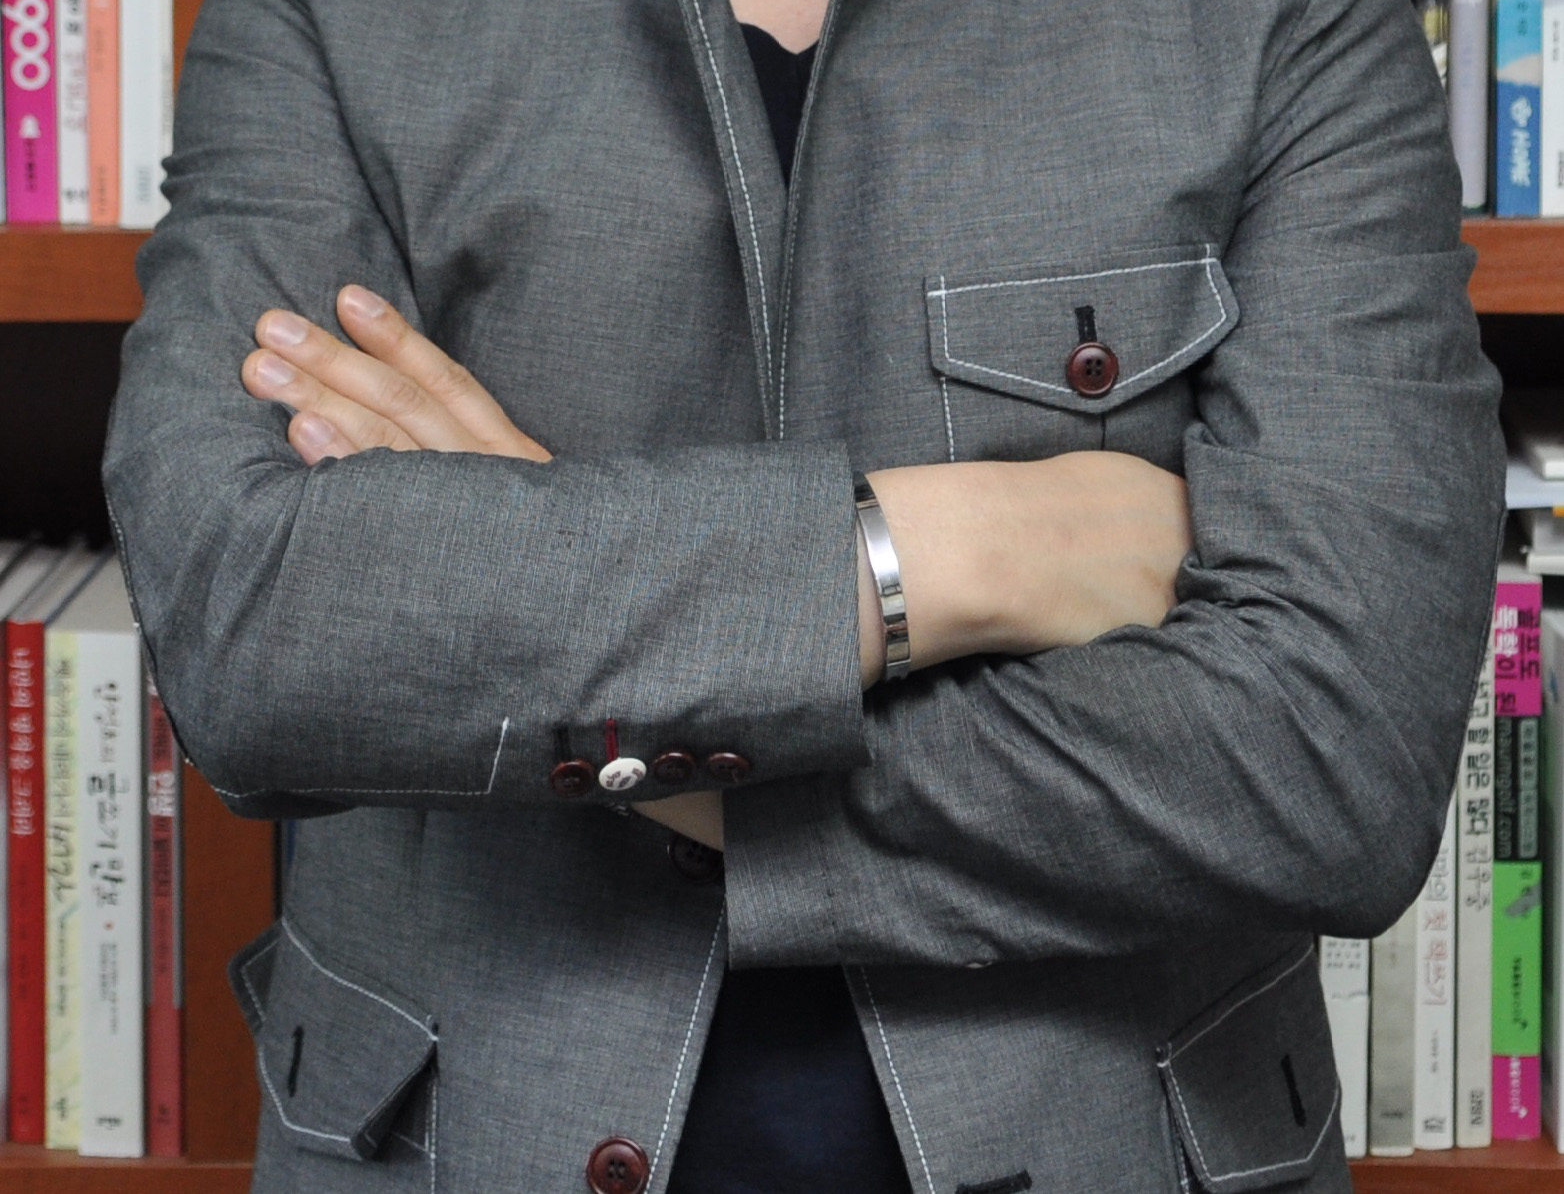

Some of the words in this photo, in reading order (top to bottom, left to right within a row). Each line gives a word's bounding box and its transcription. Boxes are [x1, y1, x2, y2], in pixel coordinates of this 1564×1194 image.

[1518, 608, 1540, 680] 골프도
[1468, 727, 1490, 744] 할
[1467, 752, 1491, 790] 일은
[1465, 799, 1491, 836] 많다
[1464, 846, 1491, 911] 김우중
